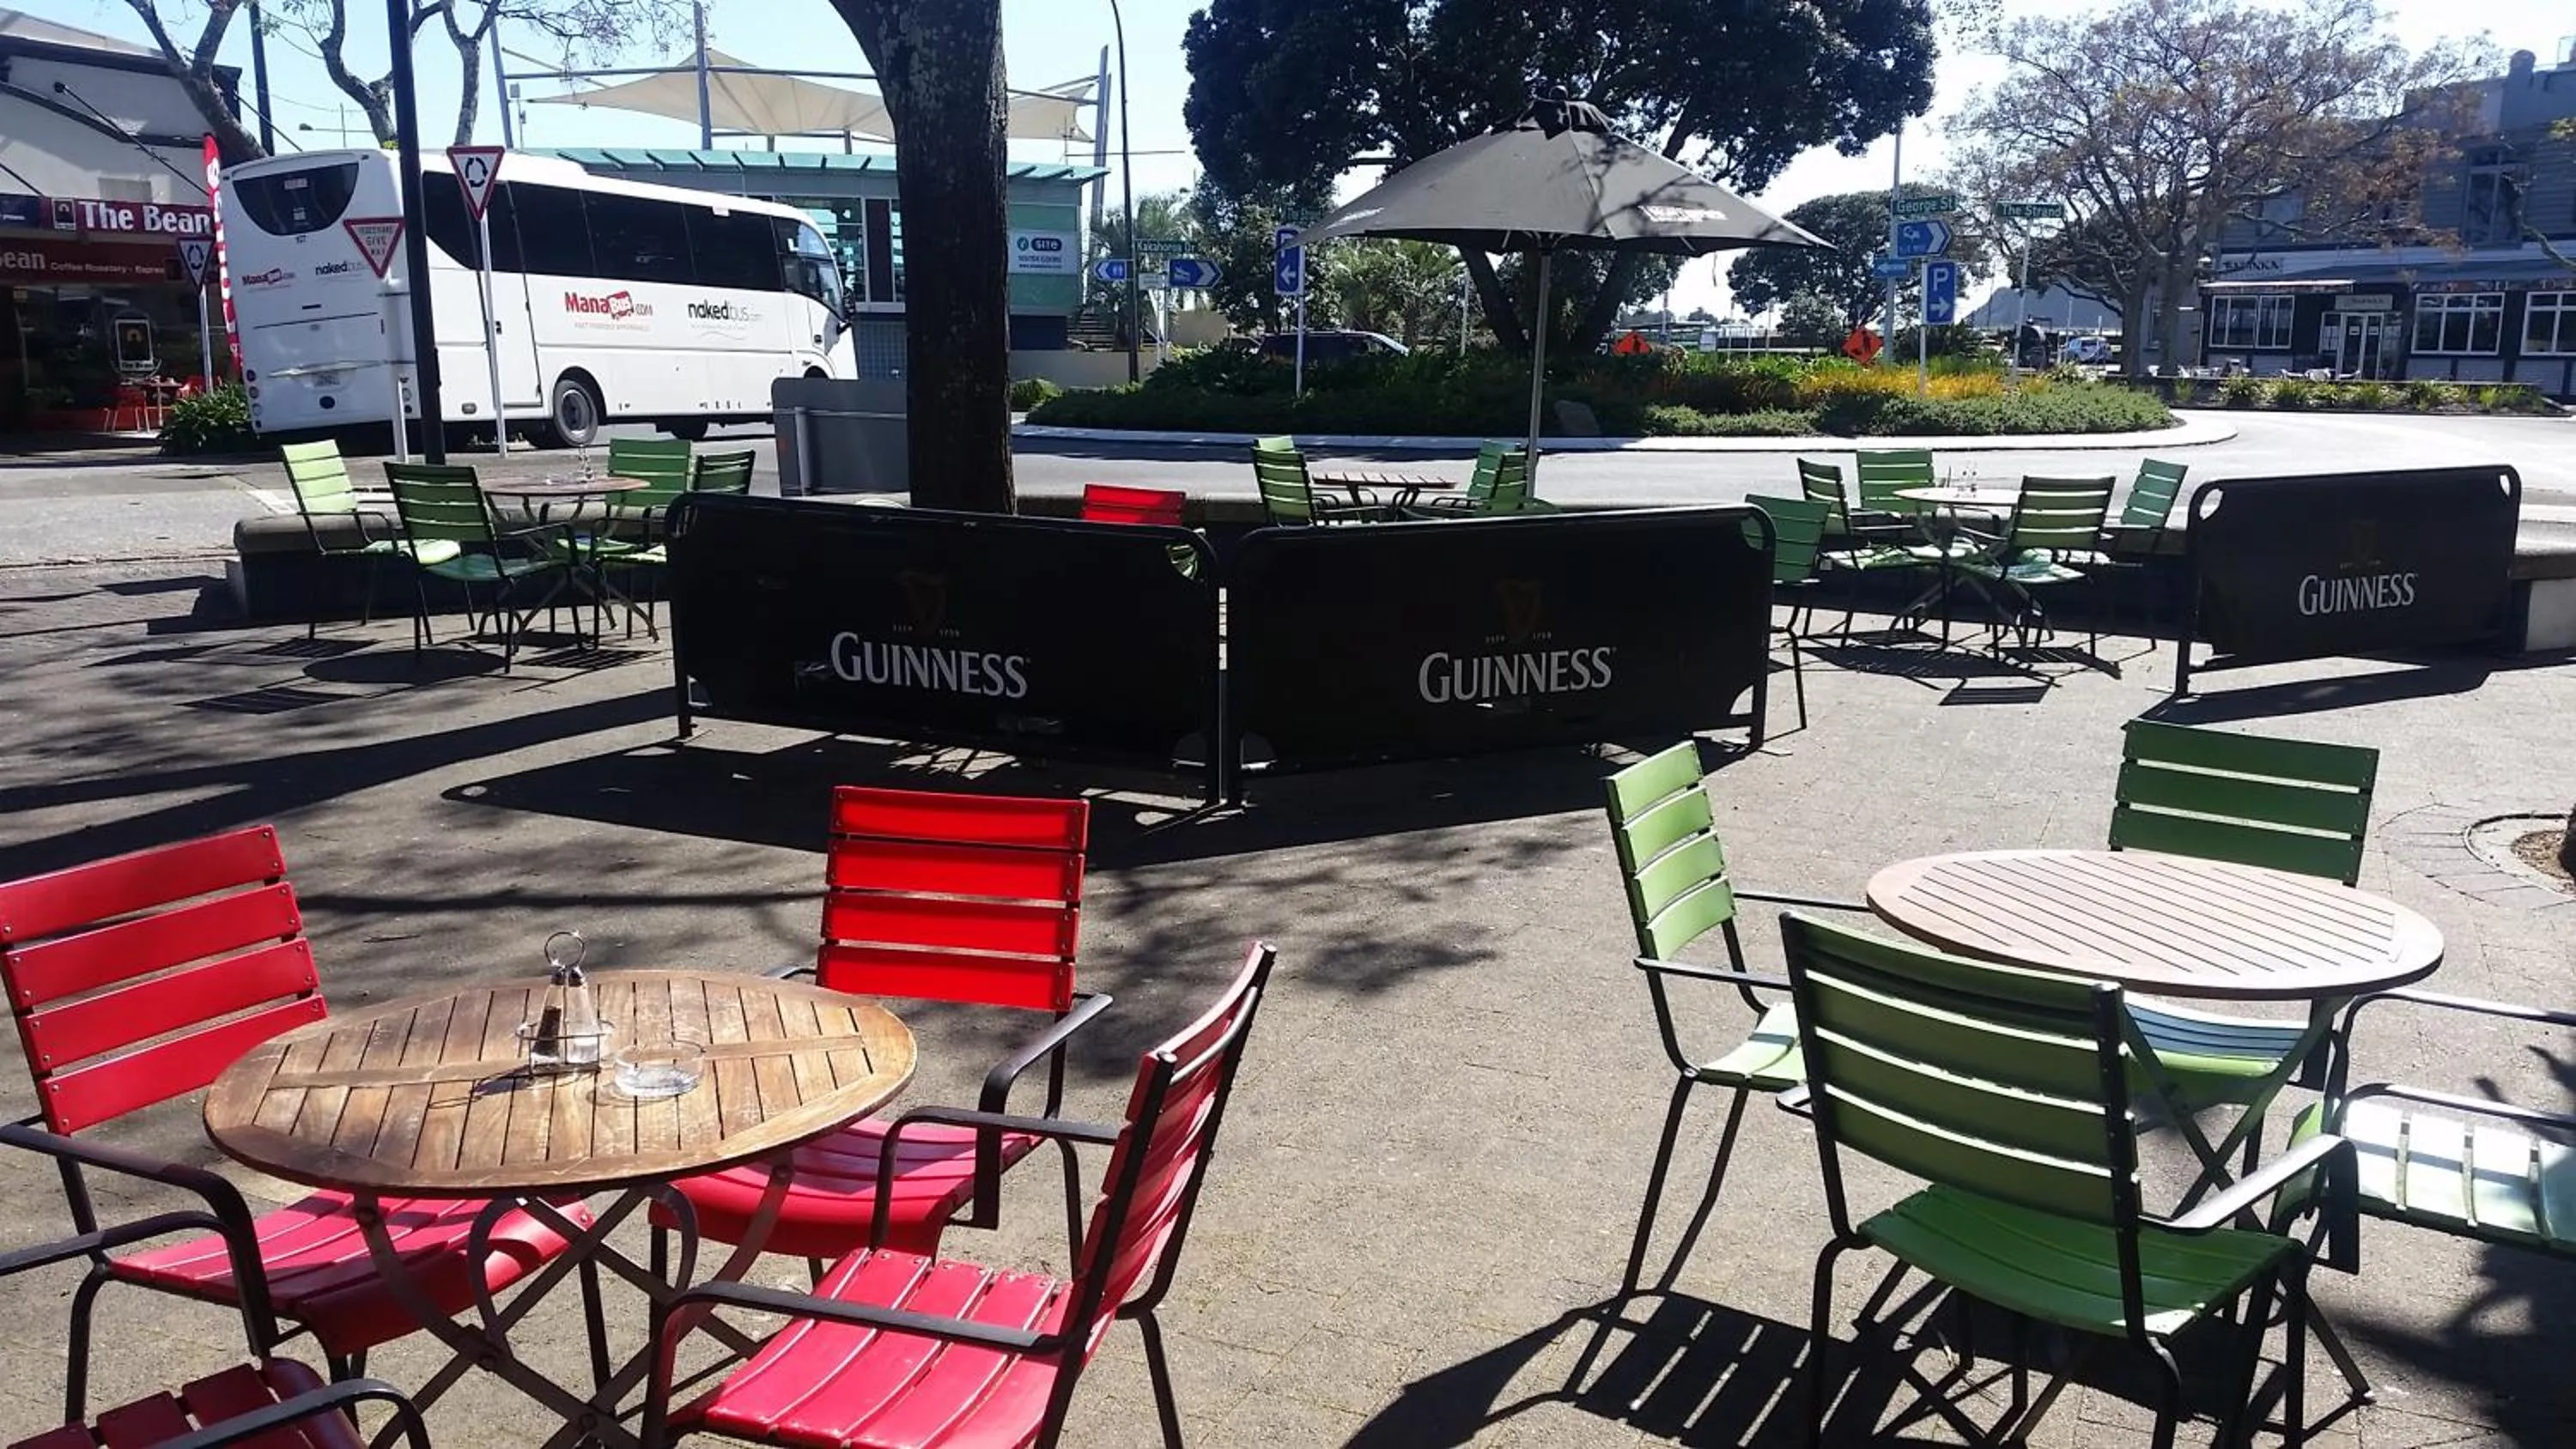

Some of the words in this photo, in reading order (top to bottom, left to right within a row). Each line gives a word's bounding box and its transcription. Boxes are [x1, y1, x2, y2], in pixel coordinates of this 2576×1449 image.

[77, 201, 134, 230] The
[143, 204, 210, 233] Bean
[1897, 199, 1937, 213] George
[1940, 197, 1953, 210] St
[2002, 203, 2022, 215] The
[2024, 204, 2062, 217] Strand
[0, 250, 46, 270] ean
[1933, 267, 1949, 292] P
[2299, 572, 2415, 615] GUINNESS
[830, 631, 1029, 699] GUINNESS
[1418, 646, 1612, 703] GUINNESS
